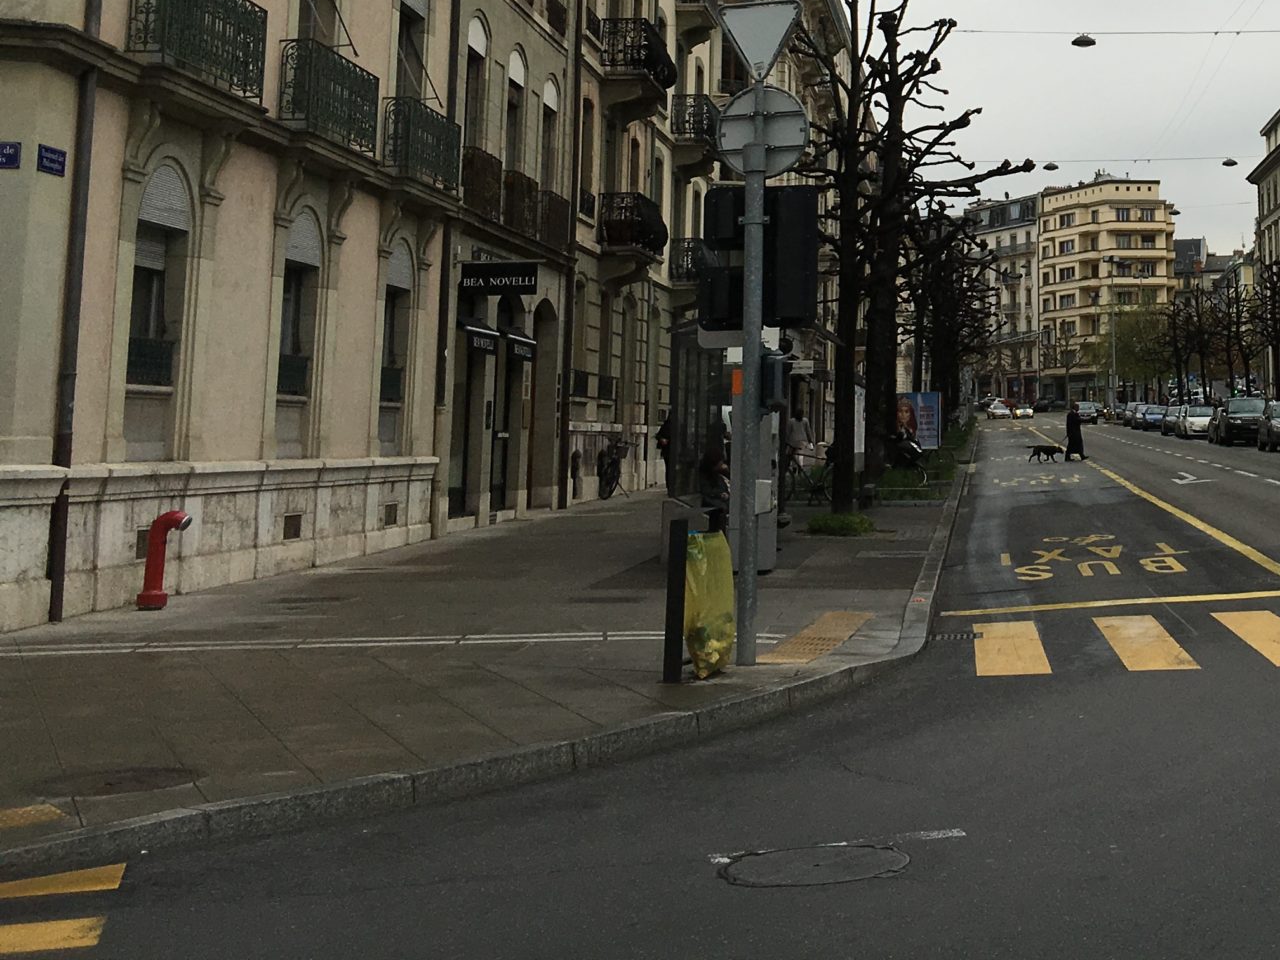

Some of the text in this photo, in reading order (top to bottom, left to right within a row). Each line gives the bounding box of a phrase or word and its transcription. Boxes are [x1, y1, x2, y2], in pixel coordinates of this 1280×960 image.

[463, 276, 535, 287] BEA NOVELLI
[1001, 542, 1190, 566] TAXI
[1014, 556, 1188, 581] BUS
